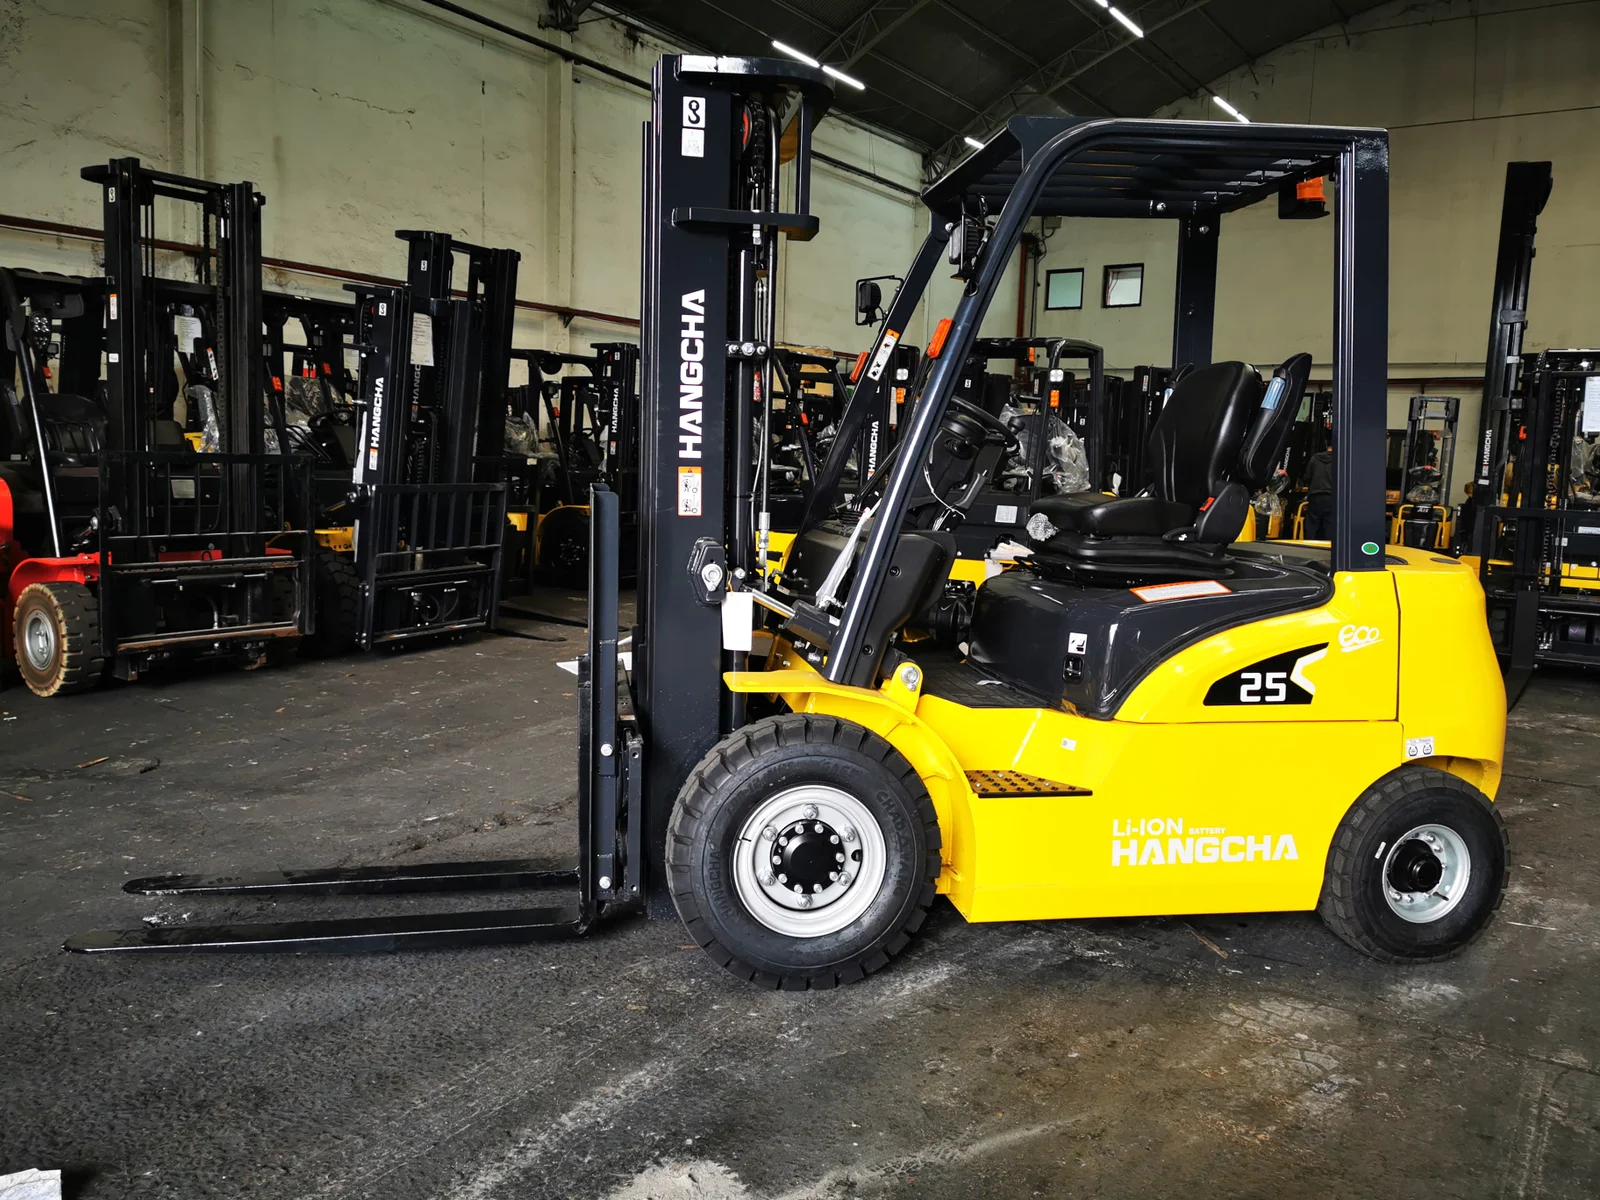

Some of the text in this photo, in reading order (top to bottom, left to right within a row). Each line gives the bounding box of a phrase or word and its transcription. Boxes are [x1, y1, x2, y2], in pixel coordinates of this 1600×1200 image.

[412, 364, 421, 404] HANGC
[678, 289, 705, 458] HANGCHA
[371, 377, 384, 448] HANGCHA
[611, 388, 619, 433] HANGCHA
[868, 421, 879, 472] HANGCHA
[1483, 430, 1492, 465] HANGCHA
[1240, 672, 1287, 702] 25
[1113, 817, 1226, 837] Li-ION BATTERY
[1111, 834, 1299, 866] HANGCHA
